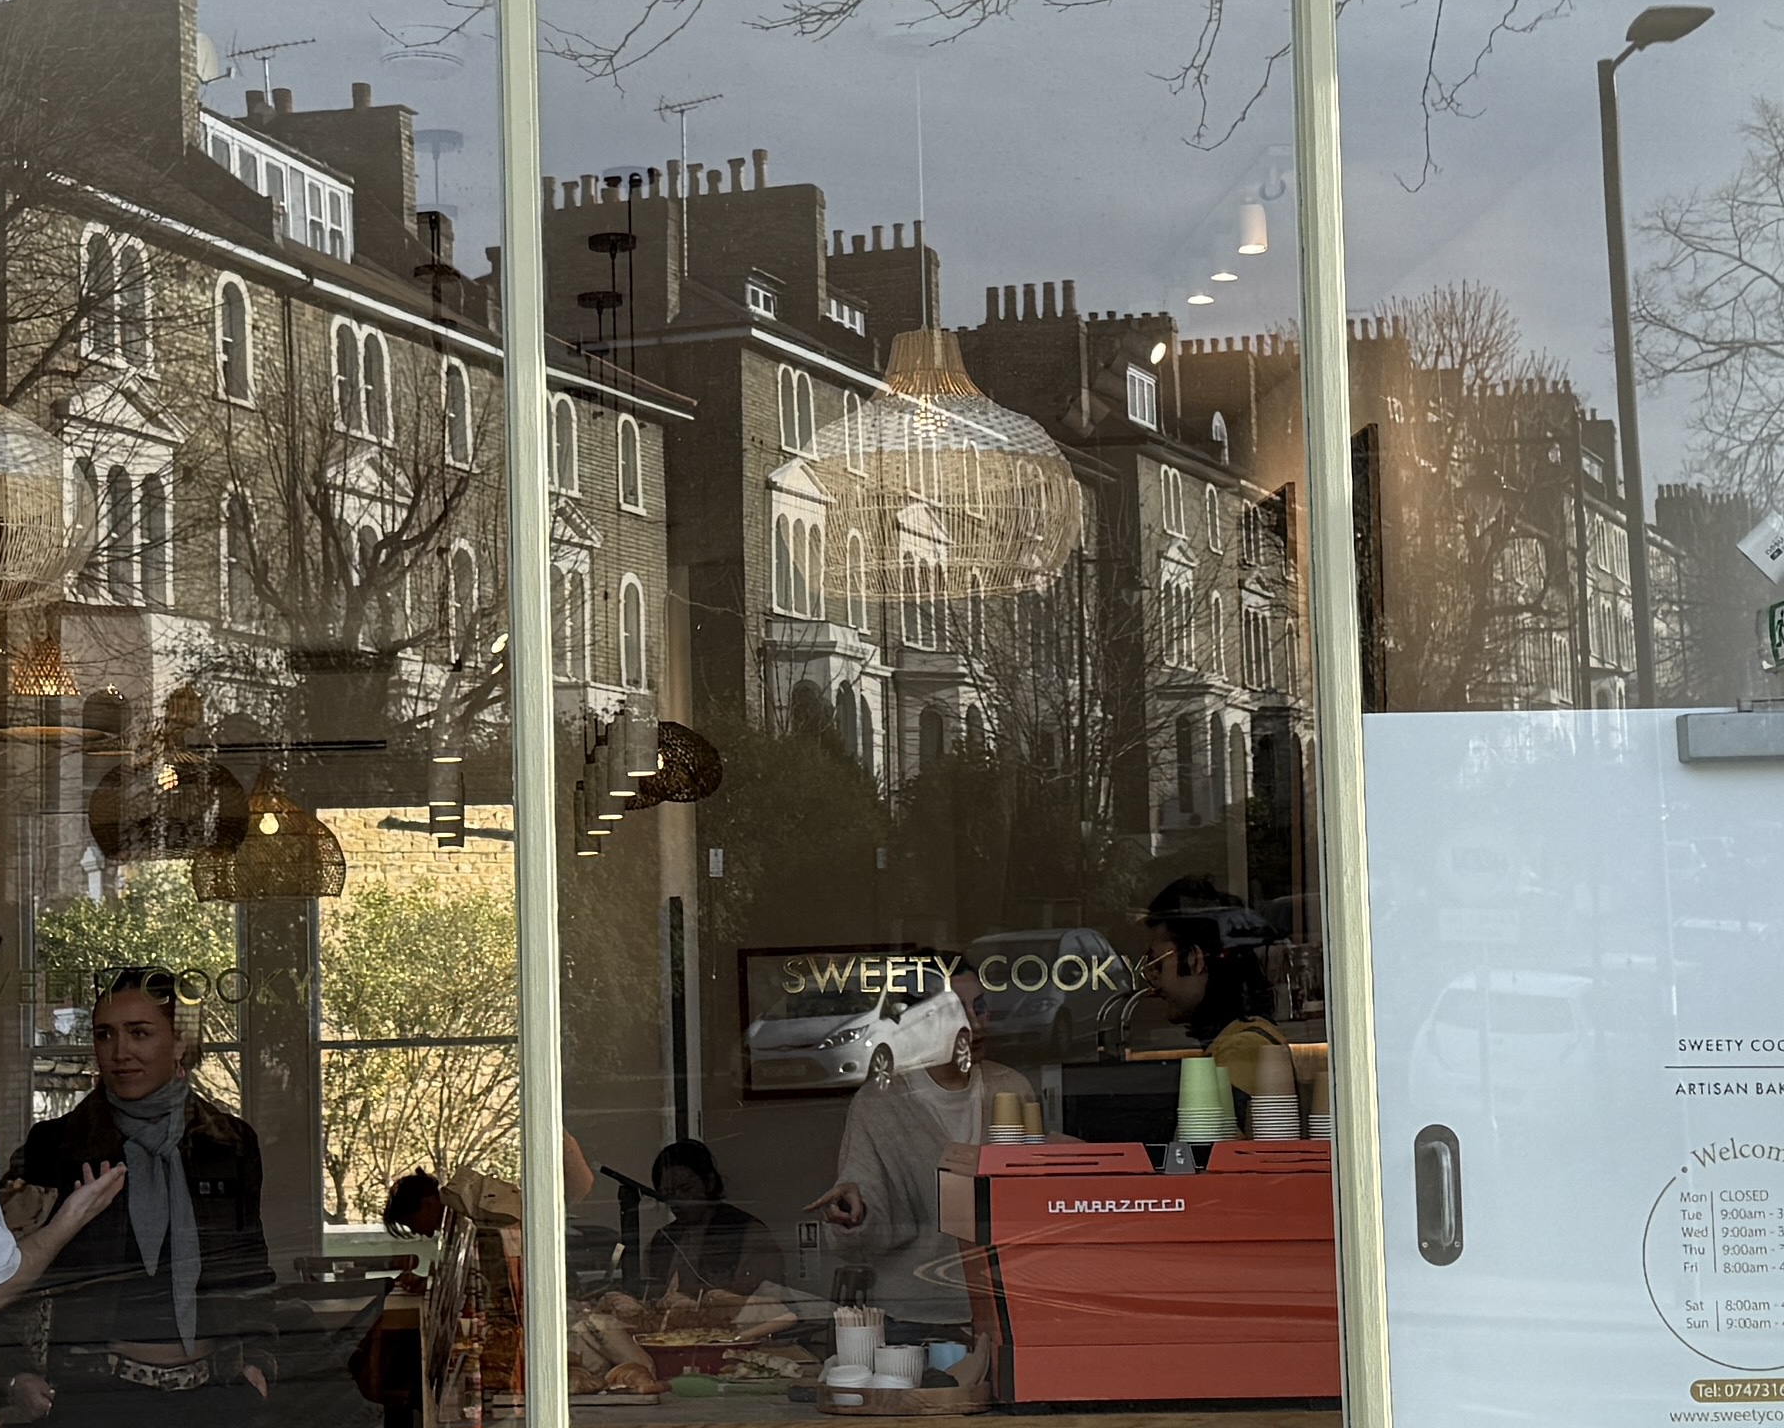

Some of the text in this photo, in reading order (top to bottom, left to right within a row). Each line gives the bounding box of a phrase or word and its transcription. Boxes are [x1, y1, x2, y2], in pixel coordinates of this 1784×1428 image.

[781, 953, 1148, 995] SWEETY COOKY
[140, 966, 315, 1006] COOKY
[1678, 1038, 1744, 1052] SWEETY
[1675, 1082, 1748, 1095] ARTISAN
[1679, 1189, 1770, 1203] Mon CLOSED
[1680, 1209, 1703, 1221] Tue
[1720, 1208, 1766, 1220] 9:00am
[1681, 1226, 1709, 1238] Wed
[1721, 1226, 1767, 1238] 9:00am
[1682, 1244, 1705, 1256] Thu
[1722, 1244, 1767, 1256] 9:00am
[1683, 1261, 1698, 1273] Fri
[1723, 1262, 1768, 1274] 8:00am
[1685, 1299, 1704, 1311] Sat
[1724, 1299, 1770, 1311] 8:00am
[1686, 1317, 1709, 1329] Sun
[1726, 1317, 1772, 1329] 9:00am
[1696, 1383, 1721, 1398] Tel:
